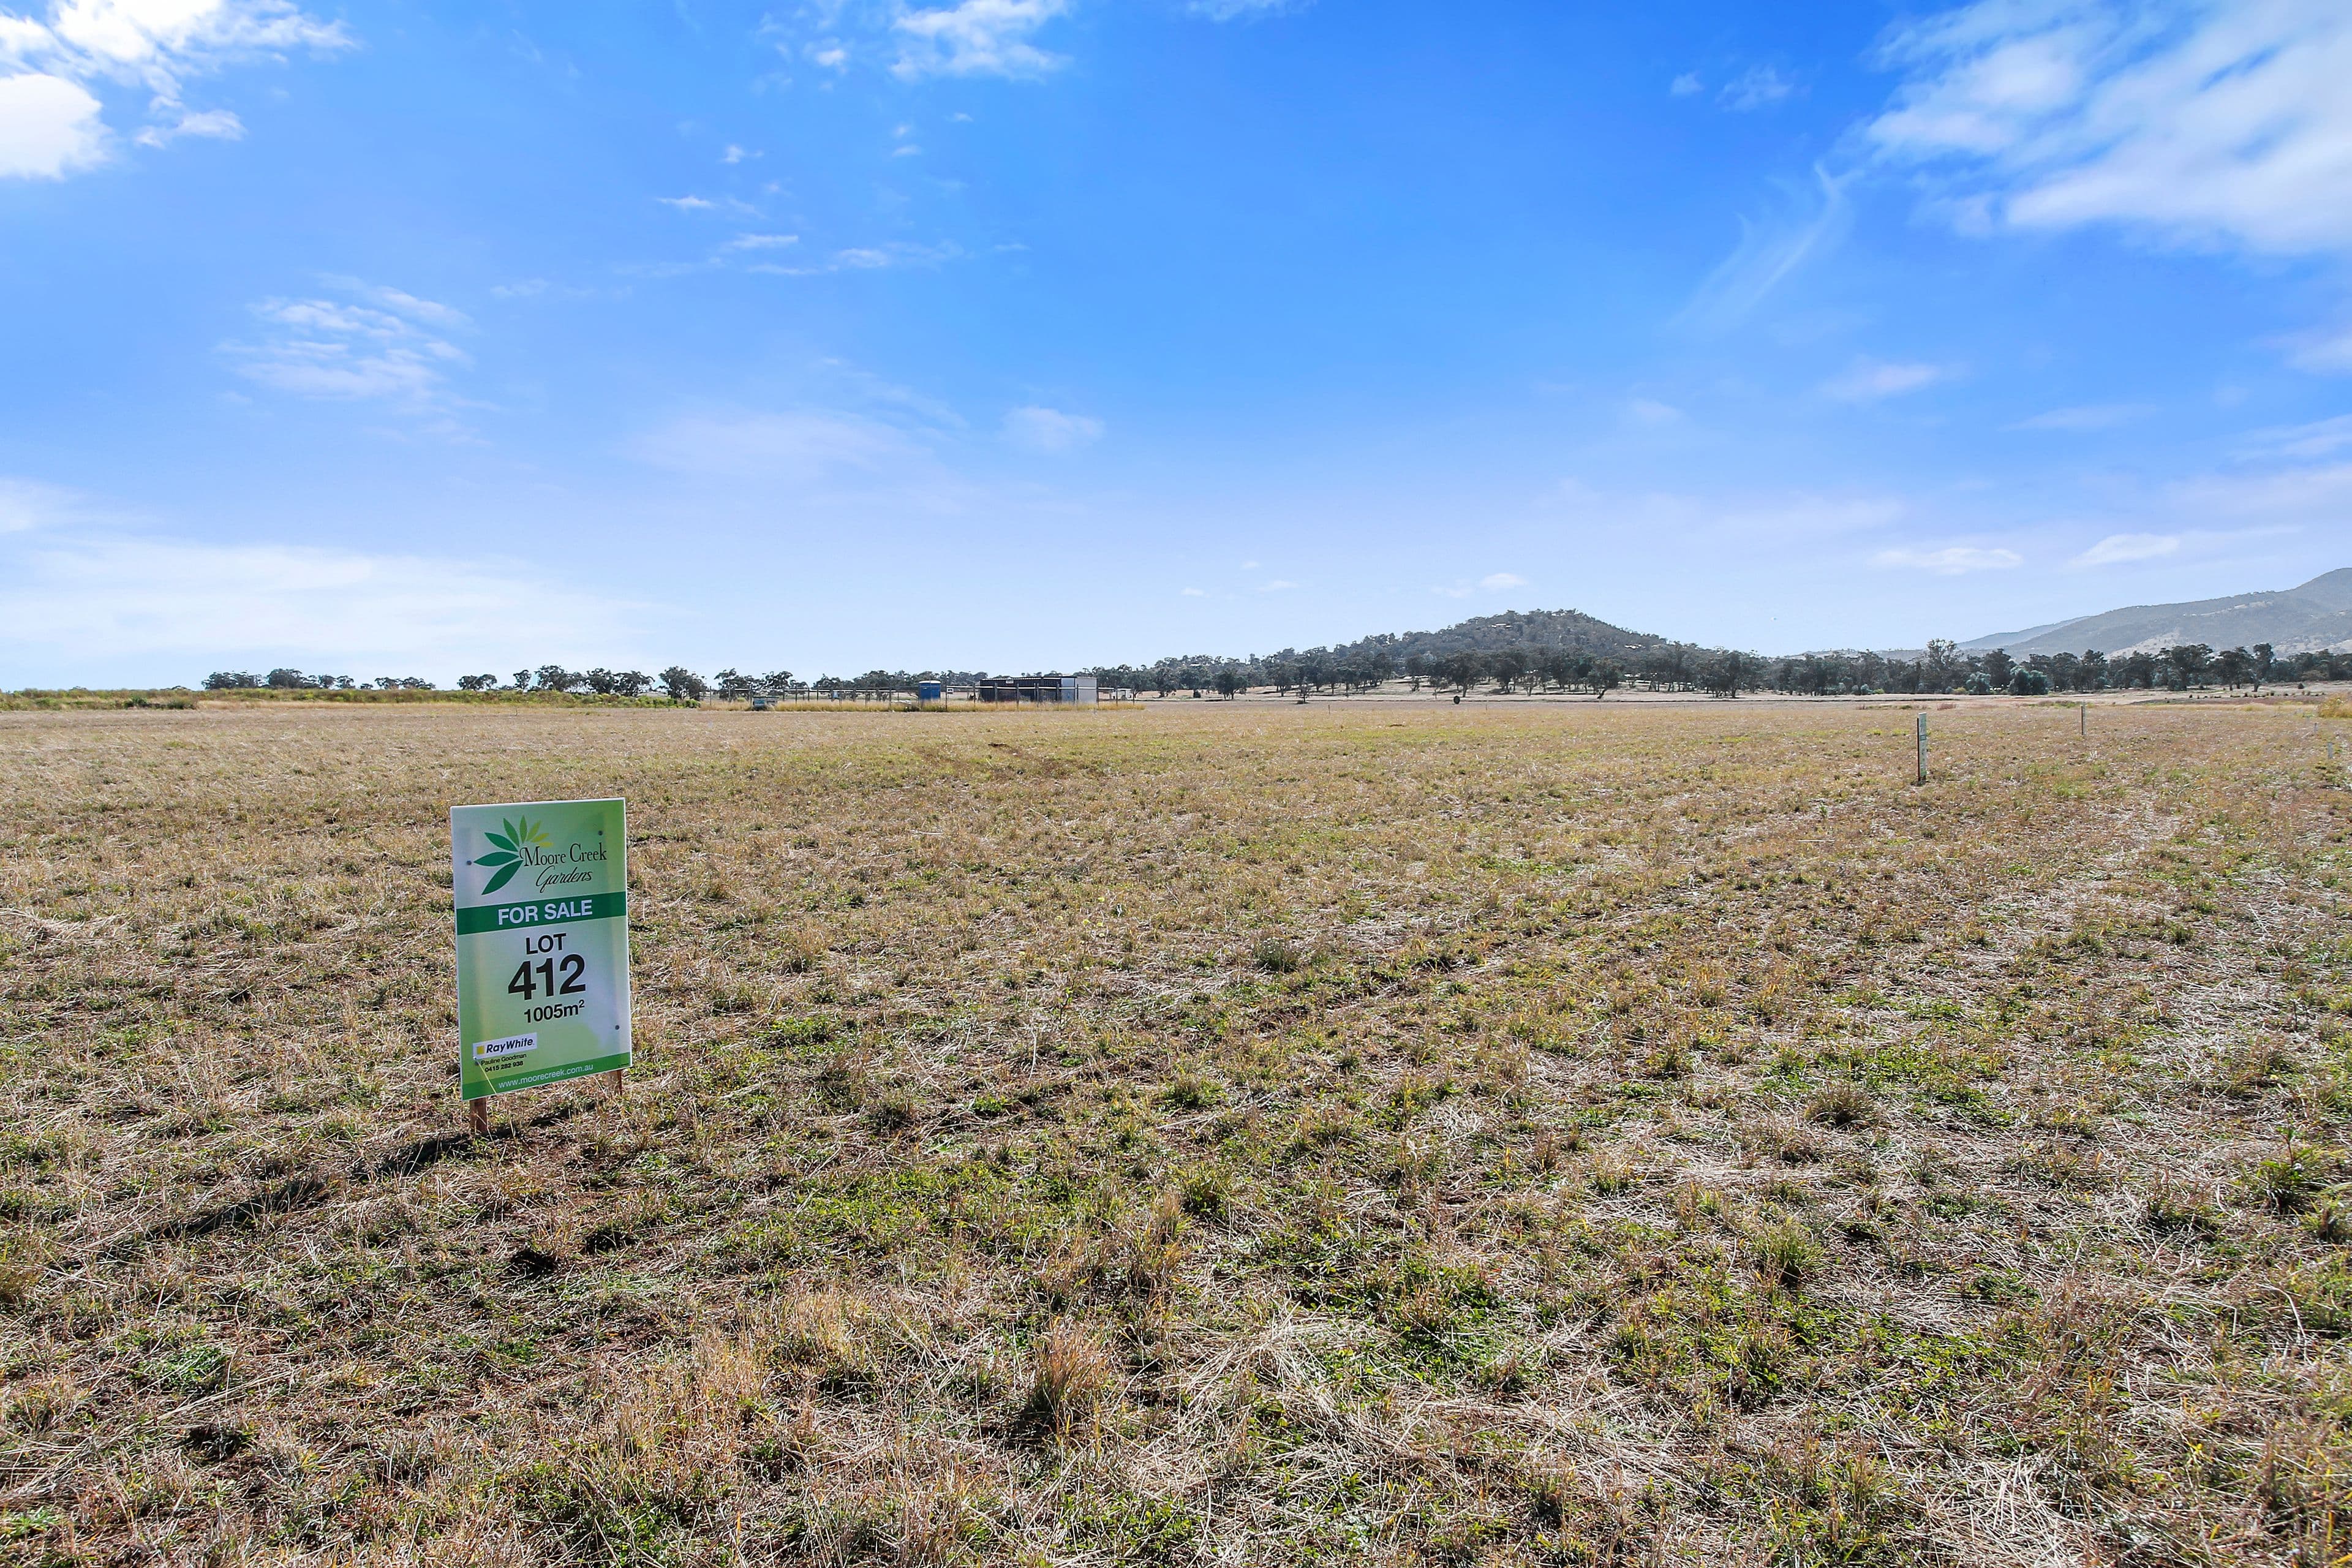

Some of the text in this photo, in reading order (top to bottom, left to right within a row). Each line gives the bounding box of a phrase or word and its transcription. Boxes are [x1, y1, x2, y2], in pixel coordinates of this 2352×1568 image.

[519, 843, 607, 866] Moore Creek
[535, 865, 593, 893] Gardens
[498, 900, 593, 925] FOR SALE
[526, 933, 567, 954] LOT
[508, 954, 586, 1000] 412
[498, 1064, 594, 1088] www.moorecreek.com.au
